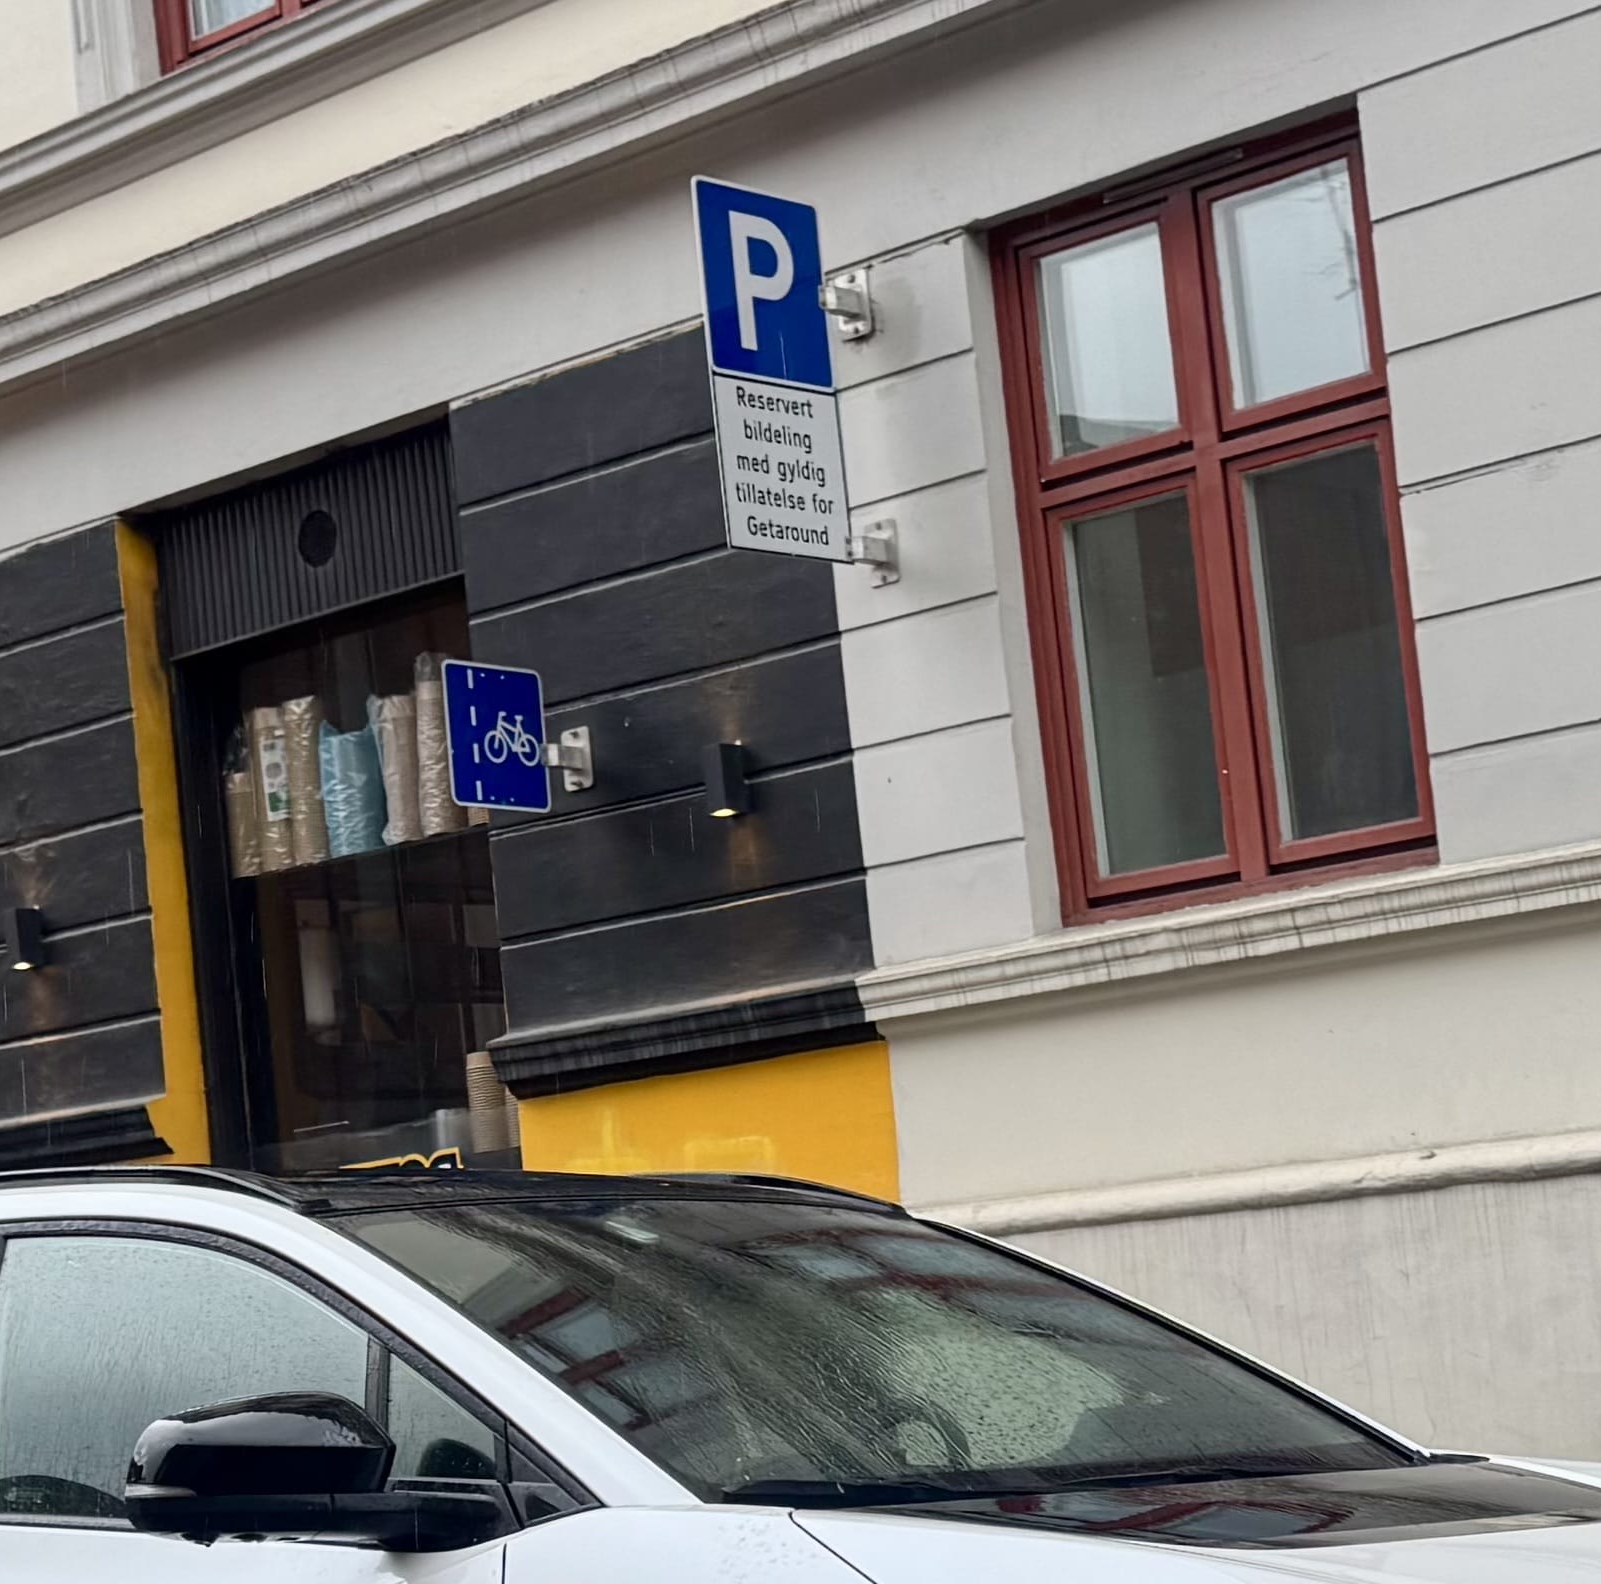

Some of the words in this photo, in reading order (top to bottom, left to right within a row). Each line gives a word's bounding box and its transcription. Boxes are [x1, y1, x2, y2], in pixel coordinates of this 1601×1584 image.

[728, 210, 795, 352] P
[736, 386, 813, 419] Reservert
[743, 420, 813, 454] bildeling
[736, 452, 770, 476] med
[777, 458, 825, 487] gyldig
[735, 482, 806, 515] tillatelse
[812, 494, 834, 515] for
[746, 516, 830, 546] Getaround
